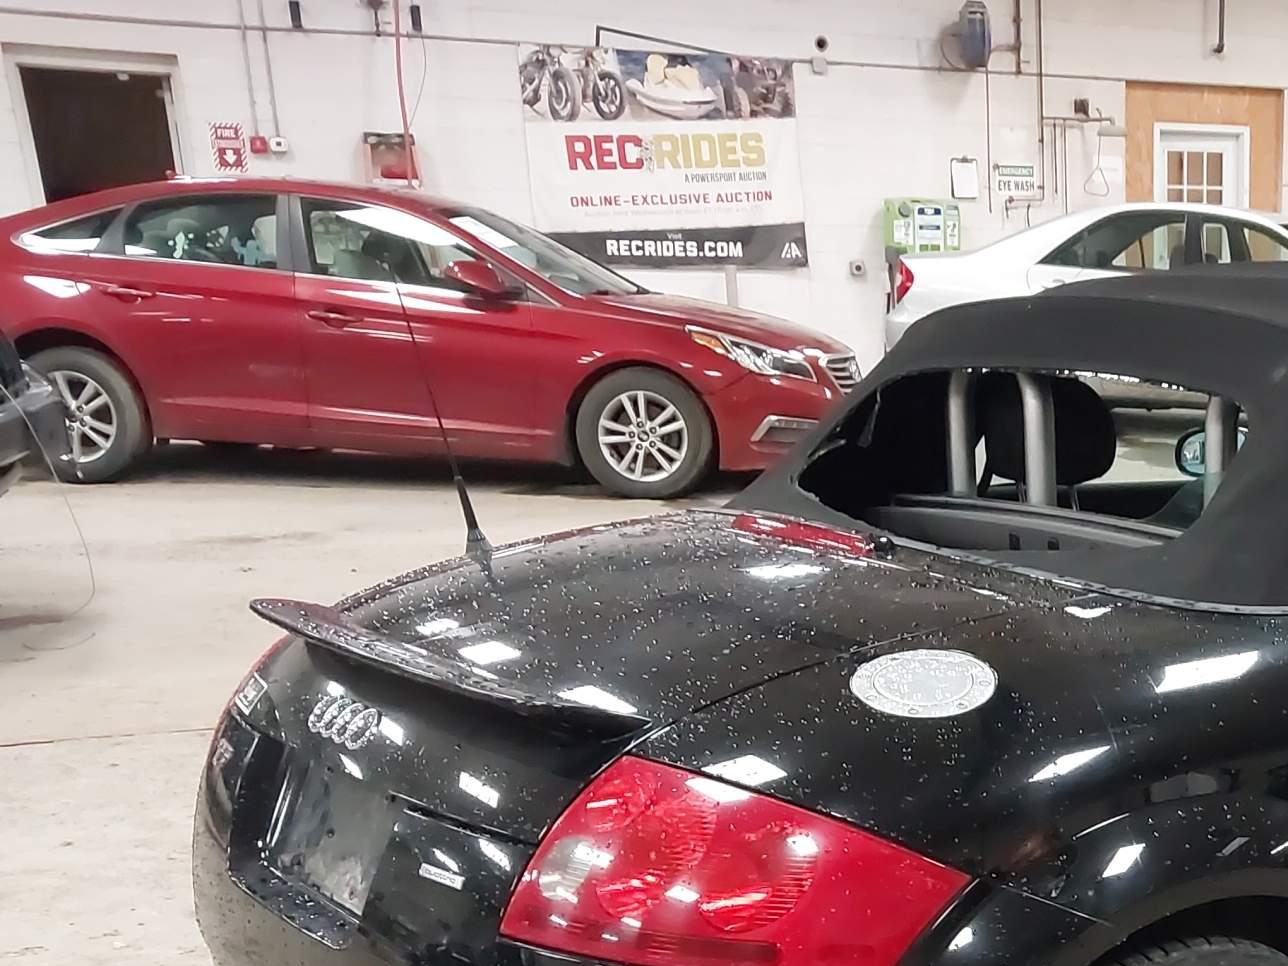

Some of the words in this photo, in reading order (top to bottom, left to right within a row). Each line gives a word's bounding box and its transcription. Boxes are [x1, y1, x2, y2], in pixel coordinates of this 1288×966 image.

[216, 128, 236, 138] FIRE
[565, 135, 644, 170] REC
[653, 132, 767, 169] RIDES
[684, 173, 690, 184] A
[691, 172, 737, 184] POWERSPORT
[739, 171, 767, 182] AUCTION
[998, 179, 1011, 192] EYE
[1014, 179, 1034, 192] WASH
[570, 193, 710, 208] ONLINE-EXCLUSIVE
[716, 190, 773, 204] AUCTION
[606, 239, 743, 258] RECRIDES.COM
